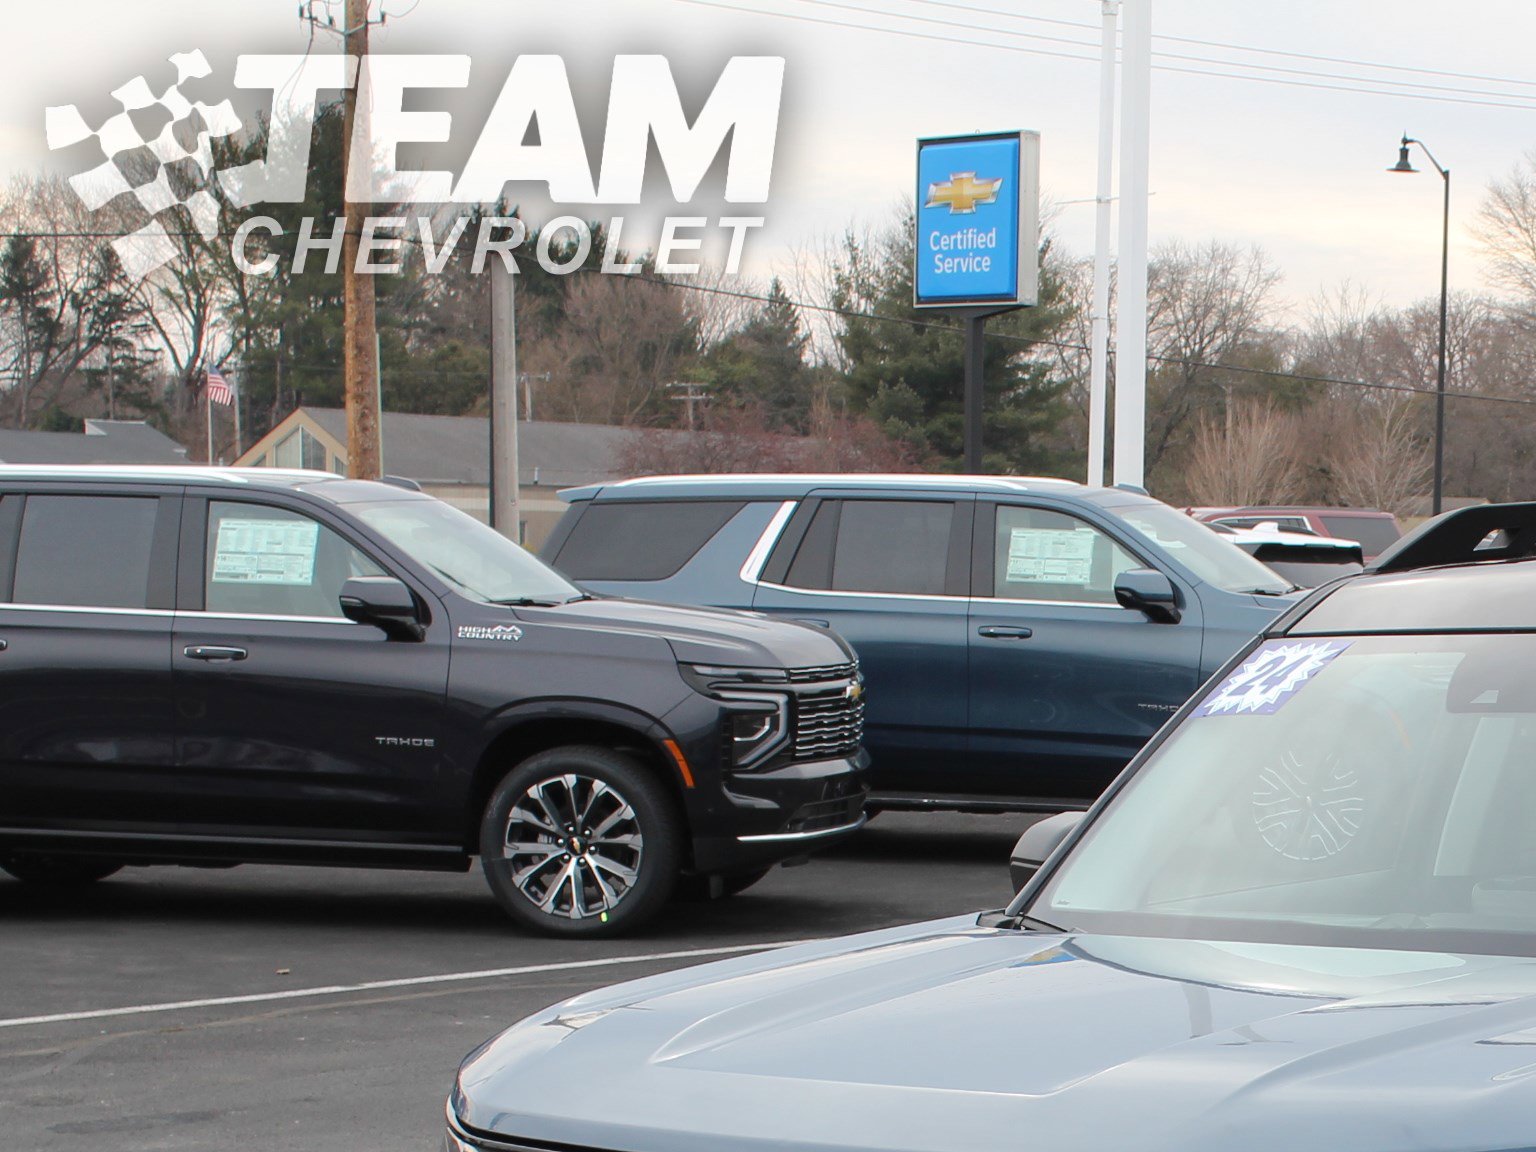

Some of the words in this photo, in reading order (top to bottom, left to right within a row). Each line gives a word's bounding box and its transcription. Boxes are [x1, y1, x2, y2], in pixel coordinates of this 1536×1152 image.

[929, 227, 997, 251] Certified
[934, 252, 991, 274] Service
[458, 625, 491, 634] HIGH
[457, 632, 521, 641] COUNTRY
[1137, 703, 1180, 712] TAHO
[375, 736, 435, 747] TAHOE
